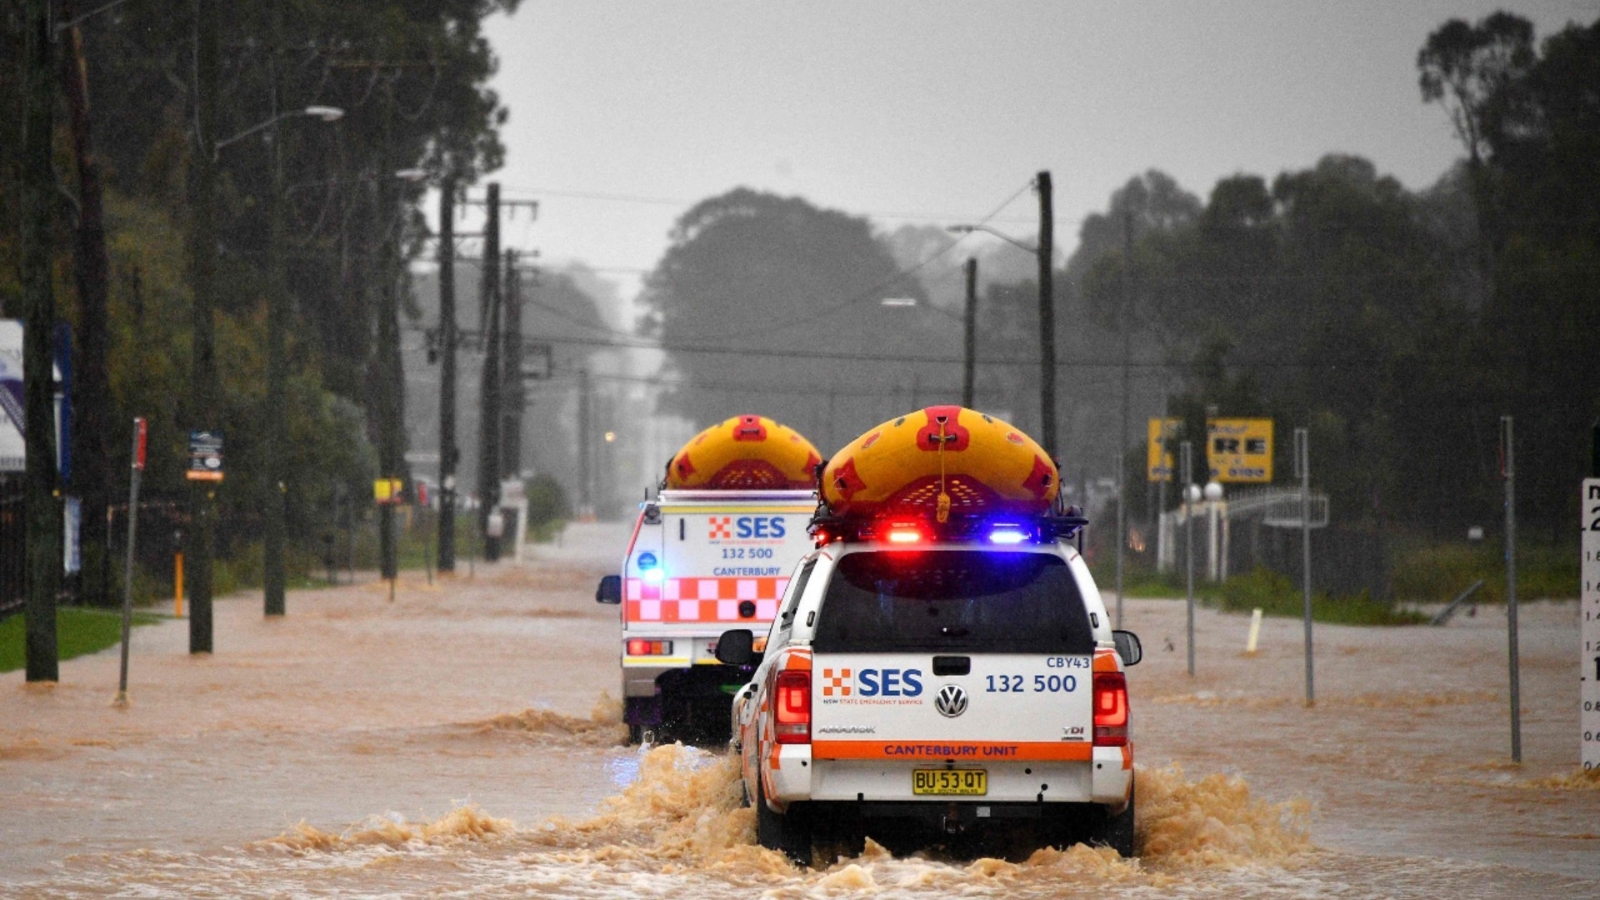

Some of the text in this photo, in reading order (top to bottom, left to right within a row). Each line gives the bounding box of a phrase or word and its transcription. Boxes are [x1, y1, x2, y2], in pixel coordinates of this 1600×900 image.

[736, 517, 786, 538] SES
[722, 549, 773, 559] 132 500
[713, 567, 780, 576] CANTERBURY
[1047, 657, 1090, 668] CBY43
[858, 668, 923, 697] SES
[986, 675, 1077, 692] 132 500
[884, 745, 1018, 756] CANTERBURY UNIT
